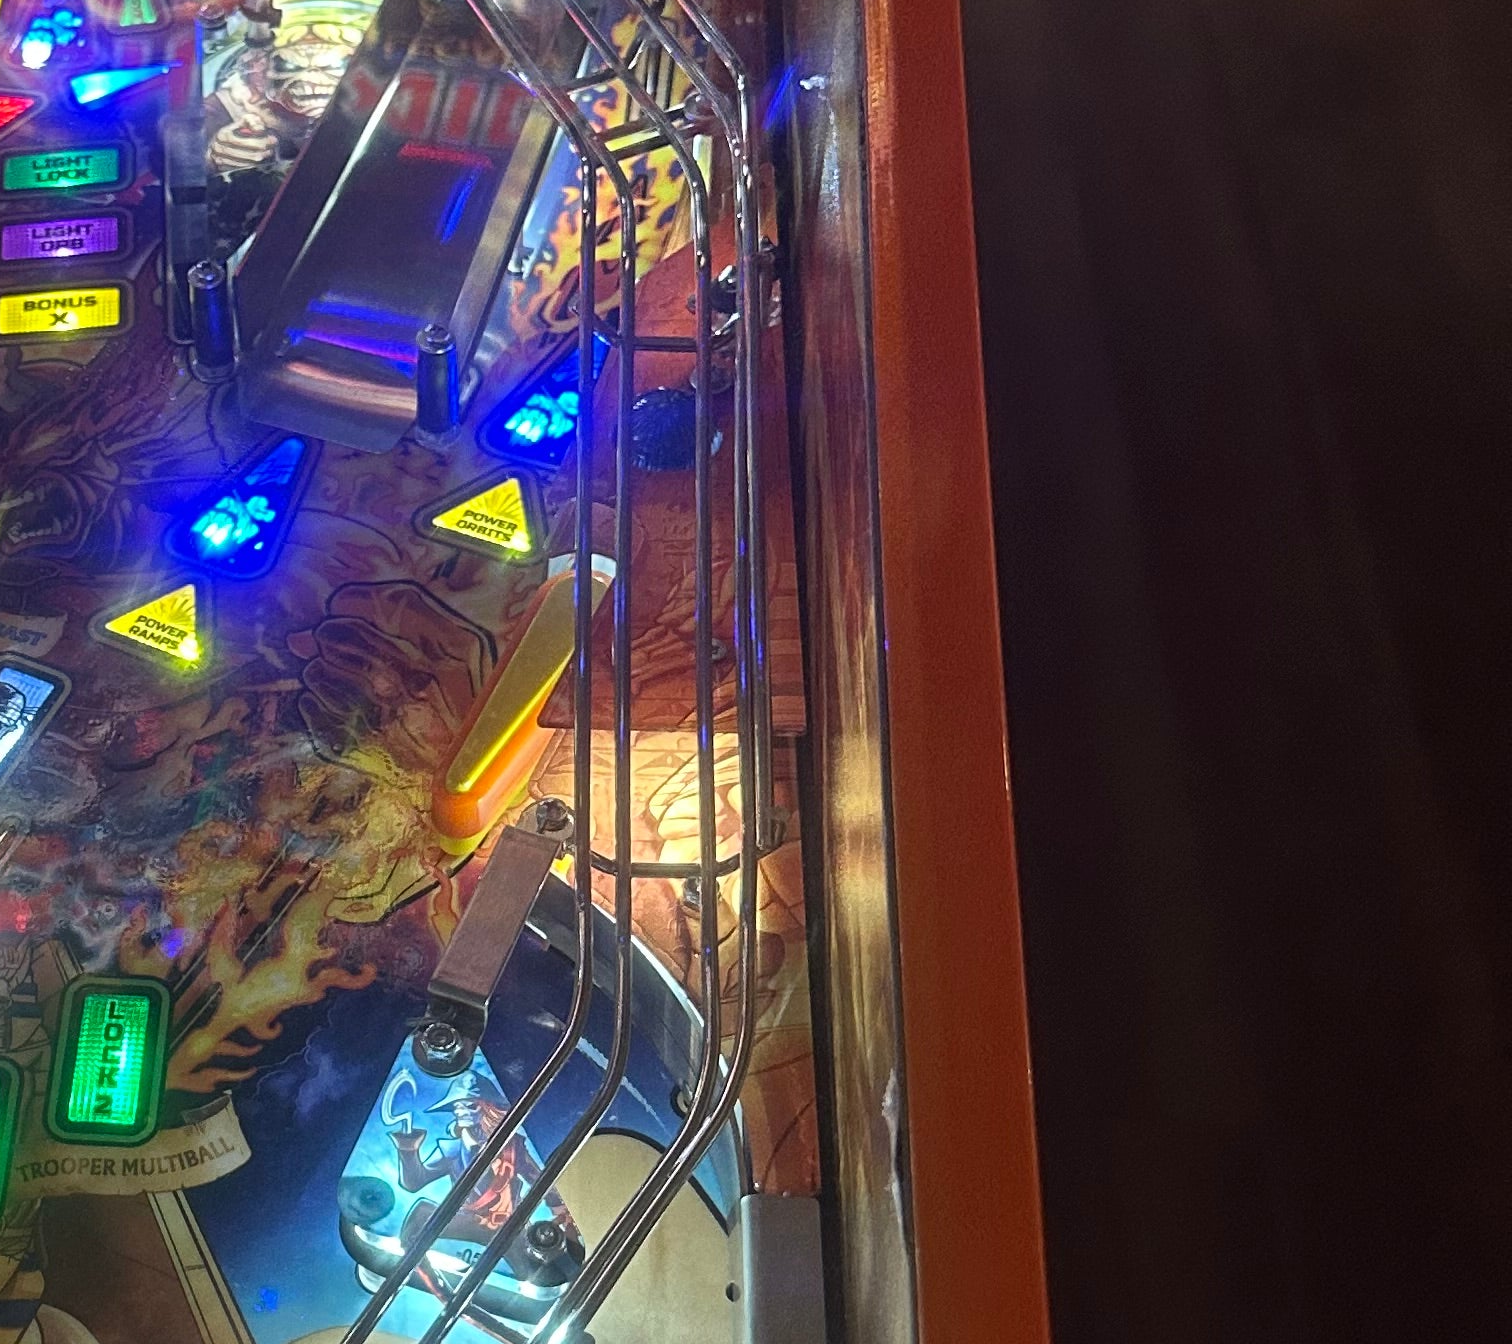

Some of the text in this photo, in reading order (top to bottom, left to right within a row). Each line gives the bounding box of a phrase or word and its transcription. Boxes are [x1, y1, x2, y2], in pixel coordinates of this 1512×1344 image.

[31, 155, 94, 170] LIGHT
[31, 223, 94, 239] LIGHT
[23, 295, 97, 312] BONUS
[49, 311, 69, 327] X
[455, 518, 513, 543] ORBITS
[462, 509, 518, 533] POWER
[128, 625, 180, 652] RAMPS
[136, 614, 189, 641] POWER
[93, 1001, 125, 1116] LOCK 2
[17, 1135, 236, 1182] TROOPER MULTIBALL
